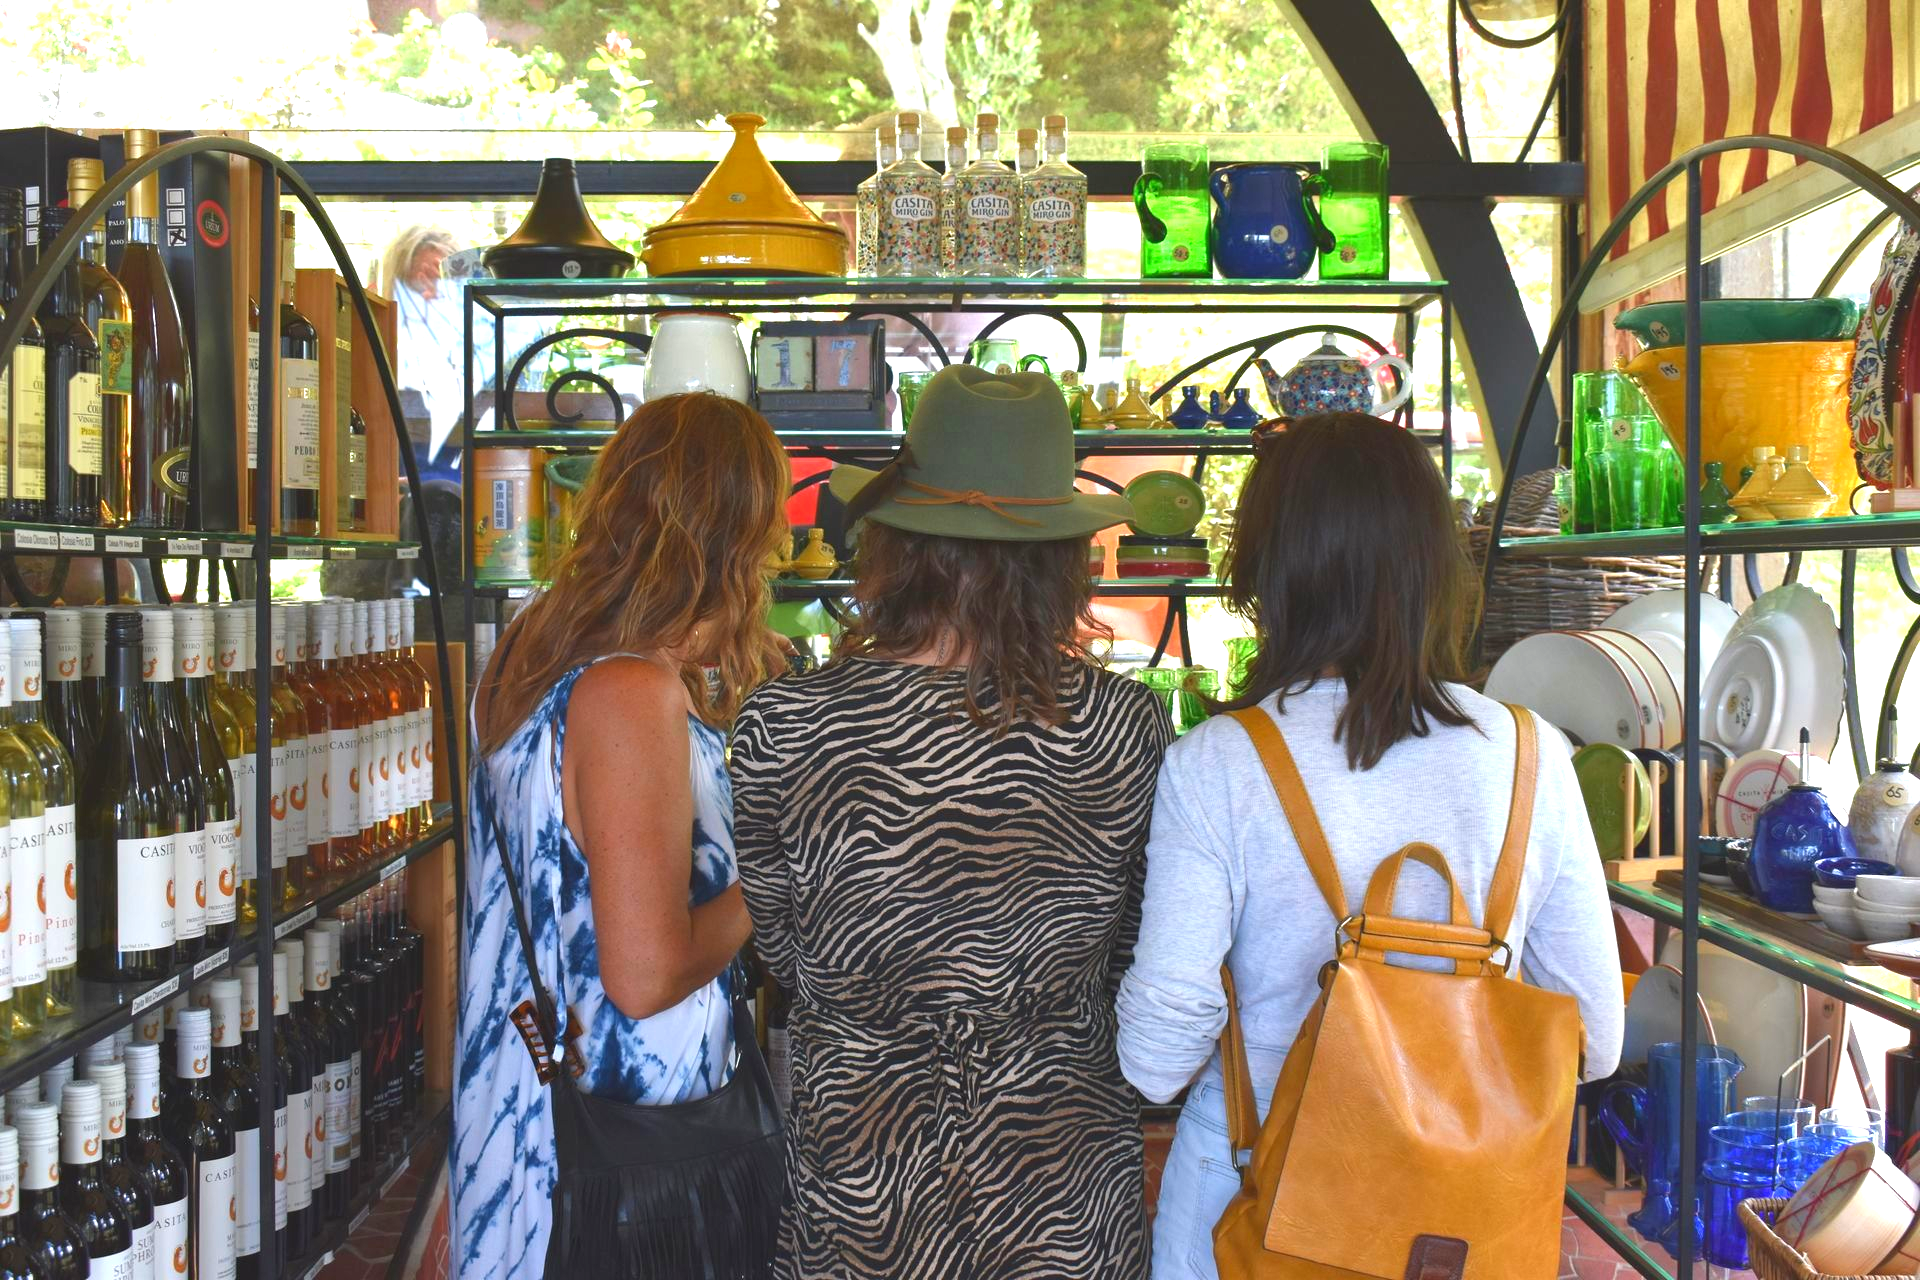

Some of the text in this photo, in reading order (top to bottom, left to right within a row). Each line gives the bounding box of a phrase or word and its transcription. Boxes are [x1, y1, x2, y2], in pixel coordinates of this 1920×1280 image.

[894, 198, 934, 210] CASITA
[971, 197, 1010, 209] CASITA
[1032, 200, 1071, 211] CASITA
[895, 209, 919, 218] MIRO
[919, 209, 934, 217] GIN
[971, 208, 1010, 218] MIRO GIN
[1032, 210, 1071, 219] MIRO GIN
[770, 339, 857, 387] 1 7
[24, 660, 41, 668] MIR
[329, 739, 359, 750] CASIT
[286, 749, 305, 760] SITA
[1886, 785, 1905, 798] 65
[47, 821, 75, 837] ASIT
[140, 843, 175, 859] CASIT
[45, 916, 75, 930] Pino
[205, 1166, 236, 1183] CASIT
[154, 1213, 186, 1230] ASITA
